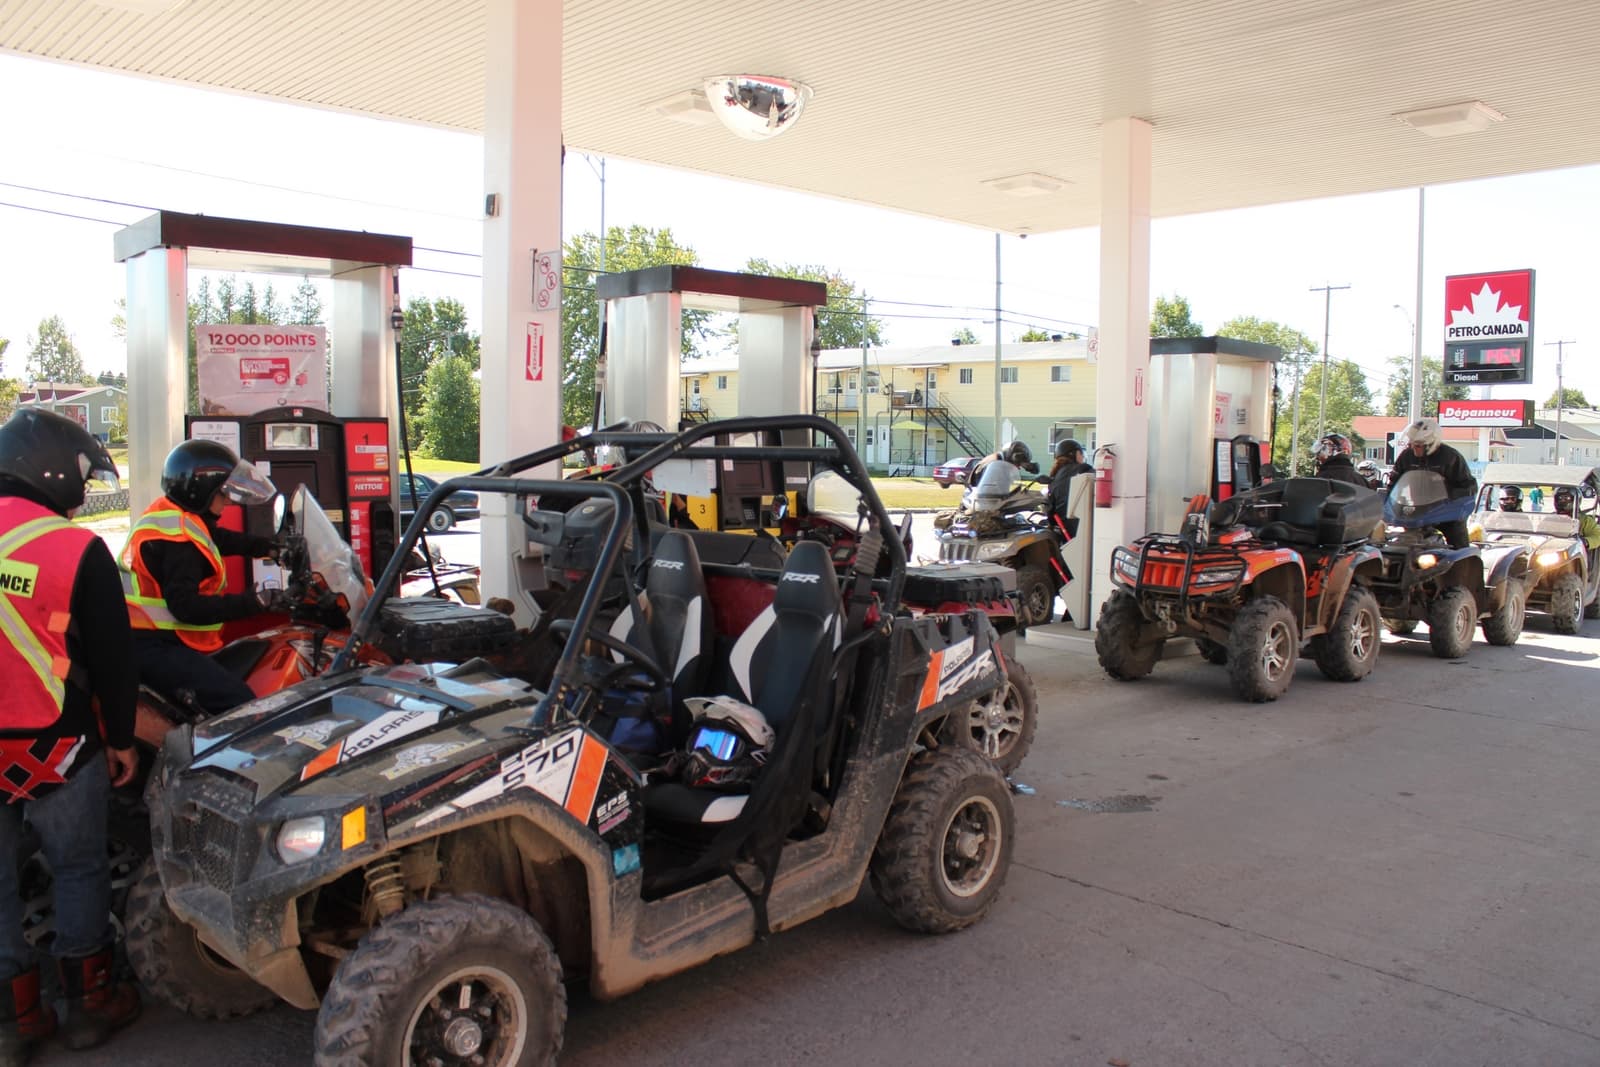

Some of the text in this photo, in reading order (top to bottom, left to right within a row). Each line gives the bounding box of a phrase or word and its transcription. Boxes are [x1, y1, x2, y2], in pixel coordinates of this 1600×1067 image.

[264, 334, 317, 346] POINTS
[1453, 373, 1479, 382] Diesel
[1445, 407, 1516, 421] Dépanneur
[362, 434, 369, 445] 1
[354, 483, 384, 491] NETTOIE
[699, 504, 706, 514] 3
[653, 559, 684, 571] RZR
[0, 573, 32, 594] NCE
[782, 571, 820, 584] RZR
[344, 710, 424, 758] POLARIS
[597, 790, 627, 818] EPS
